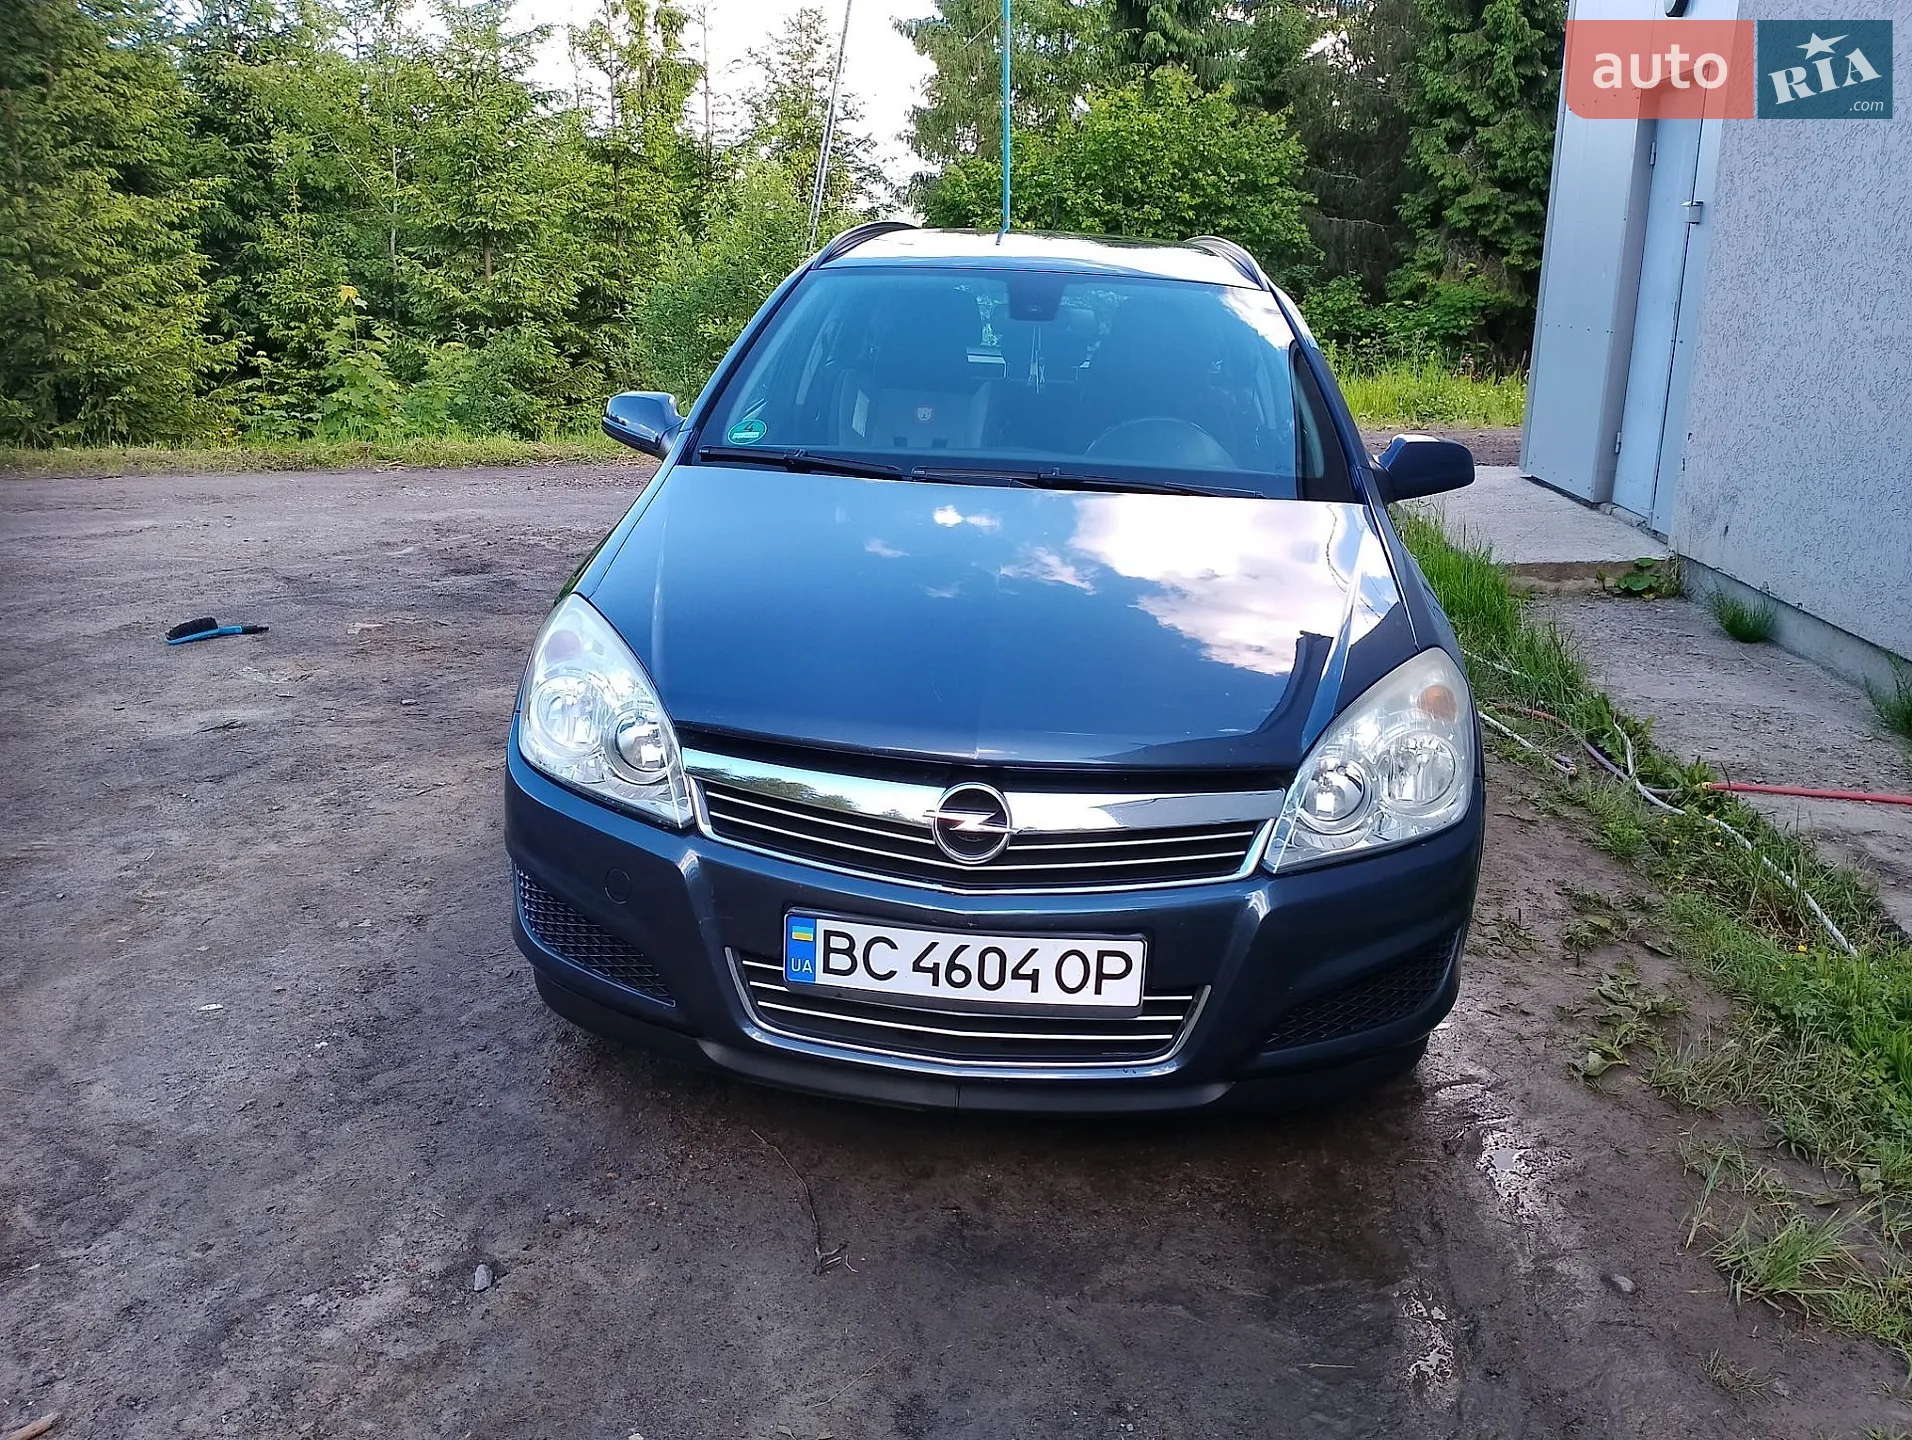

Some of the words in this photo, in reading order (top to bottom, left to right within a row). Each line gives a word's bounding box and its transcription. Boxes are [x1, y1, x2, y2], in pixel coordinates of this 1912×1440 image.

[744, 421, 754, 432] 4
[791, 957, 813, 974] UA
[821, 929, 899, 982] BC
[912, 941, 1039, 993] 4604
[1054, 948, 1133, 996] OP
